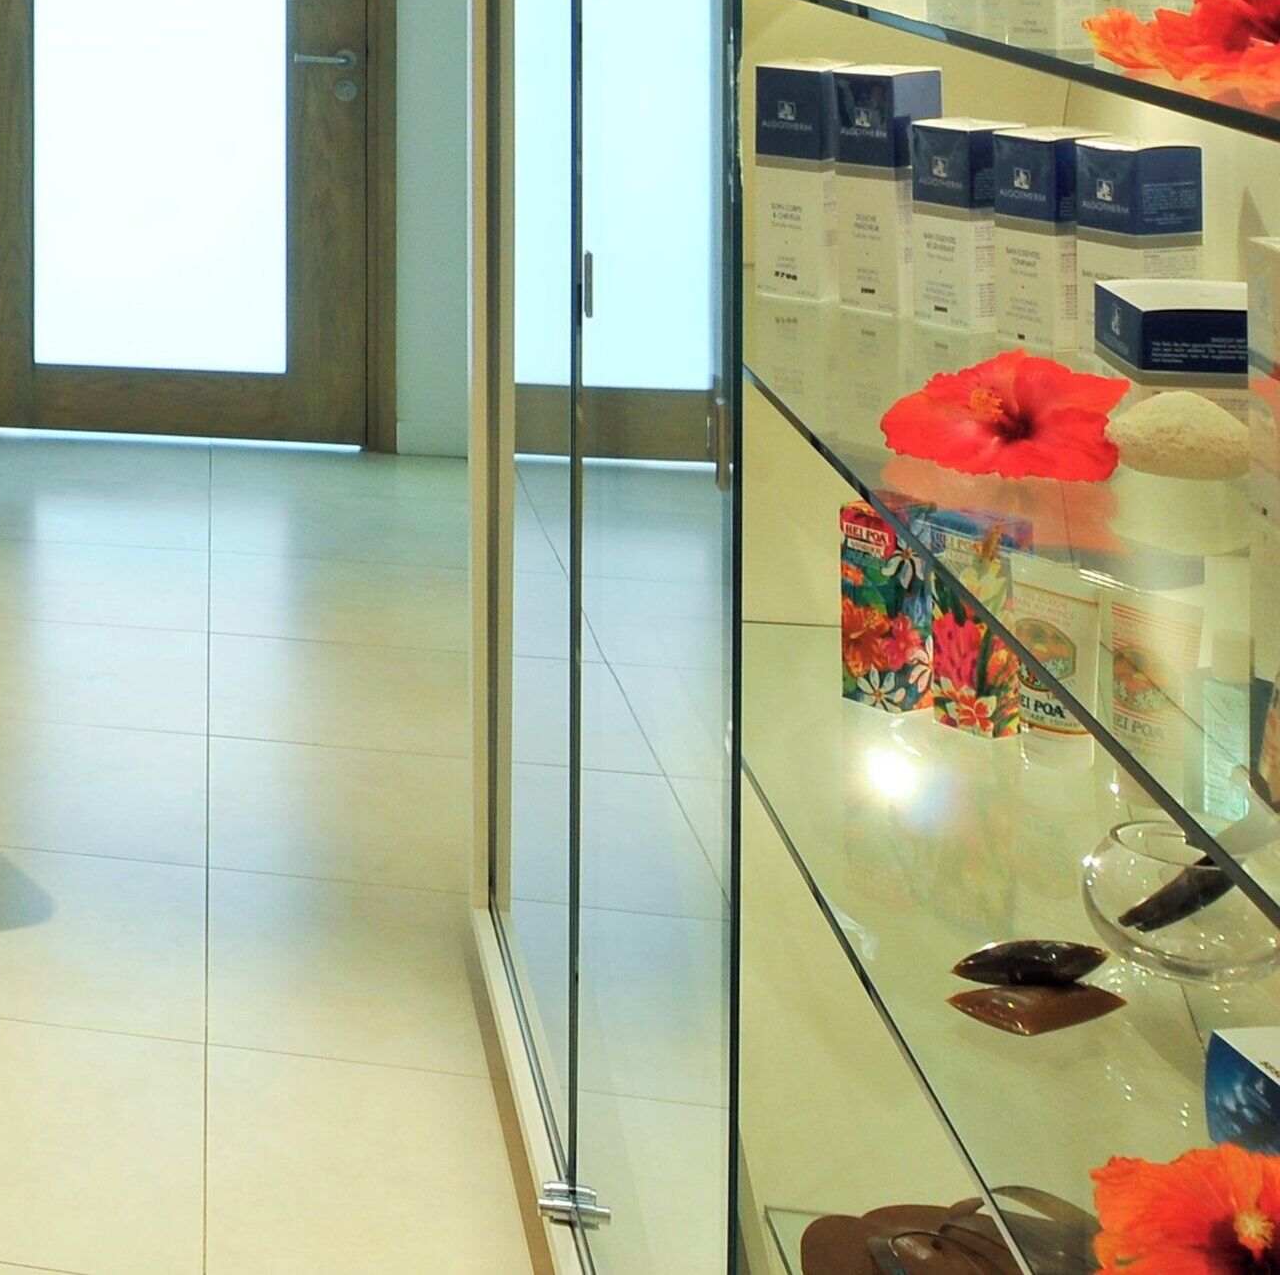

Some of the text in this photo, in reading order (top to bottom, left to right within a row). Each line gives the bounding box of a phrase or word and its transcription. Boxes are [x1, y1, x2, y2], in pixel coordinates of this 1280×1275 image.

[761, 120, 813, 132] ALGOTHERM
[840, 126, 888, 139] ALGOTHERM
[999, 188, 1047, 203] ALGOTHERM
[1081, 200, 1130, 215] ALGOTHERM
[845, 523, 888, 545] HEI POA
[1033, 700, 1066, 720] POA
